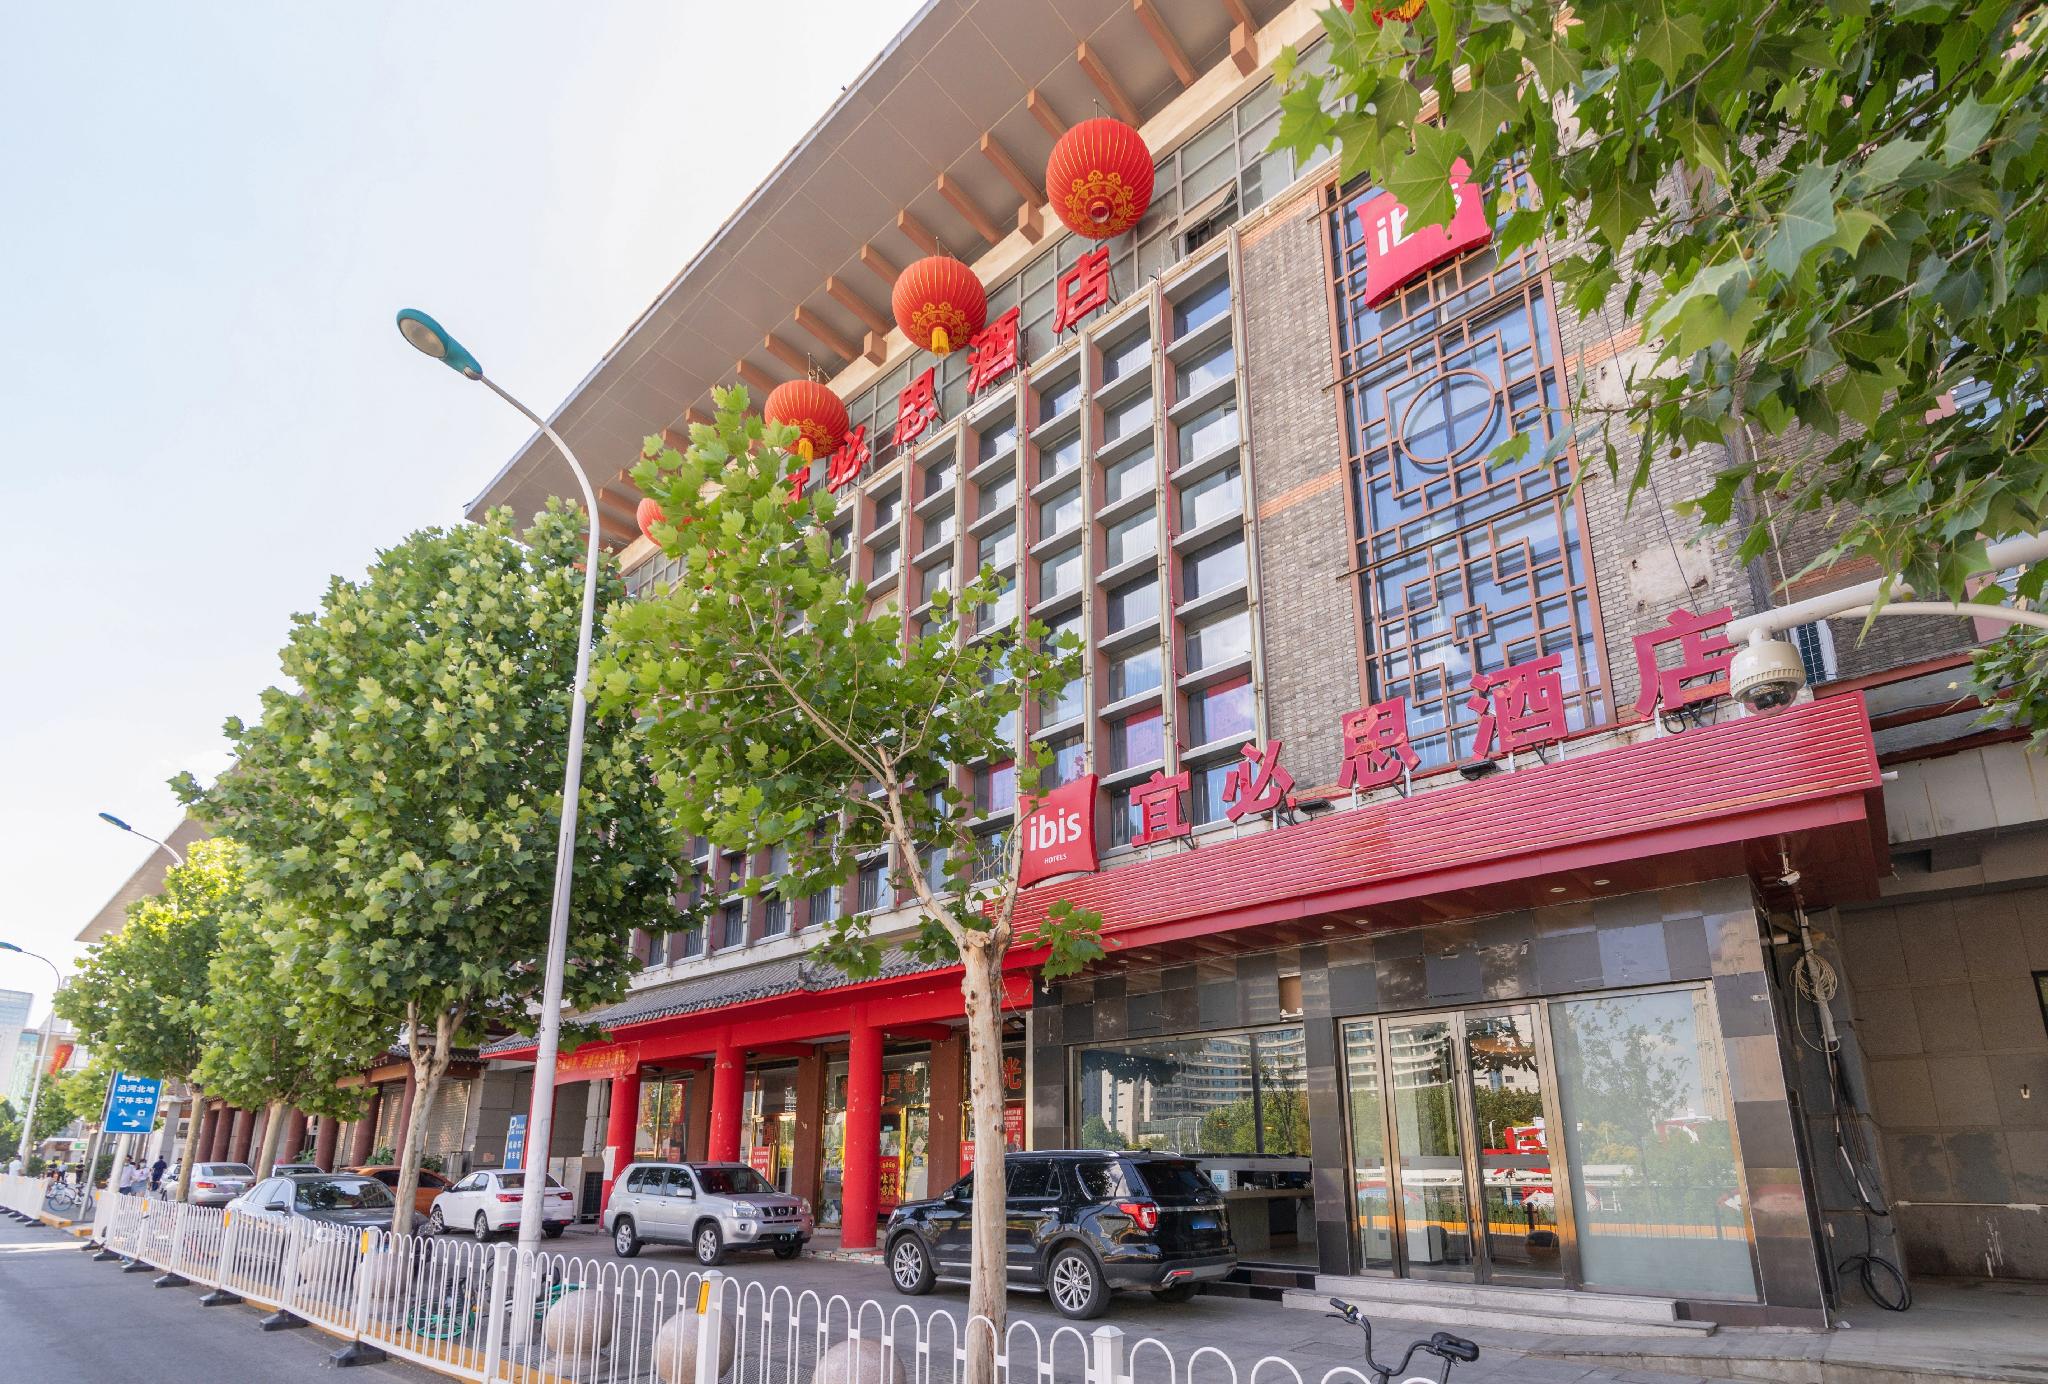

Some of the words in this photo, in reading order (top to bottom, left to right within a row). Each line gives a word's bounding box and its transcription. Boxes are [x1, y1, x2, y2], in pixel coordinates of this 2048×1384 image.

[1130, 606, 1738, 848] 宜必思酒店
[1030, 808, 1081, 851] ibis
[1044, 854, 1067, 864] HOTELS
